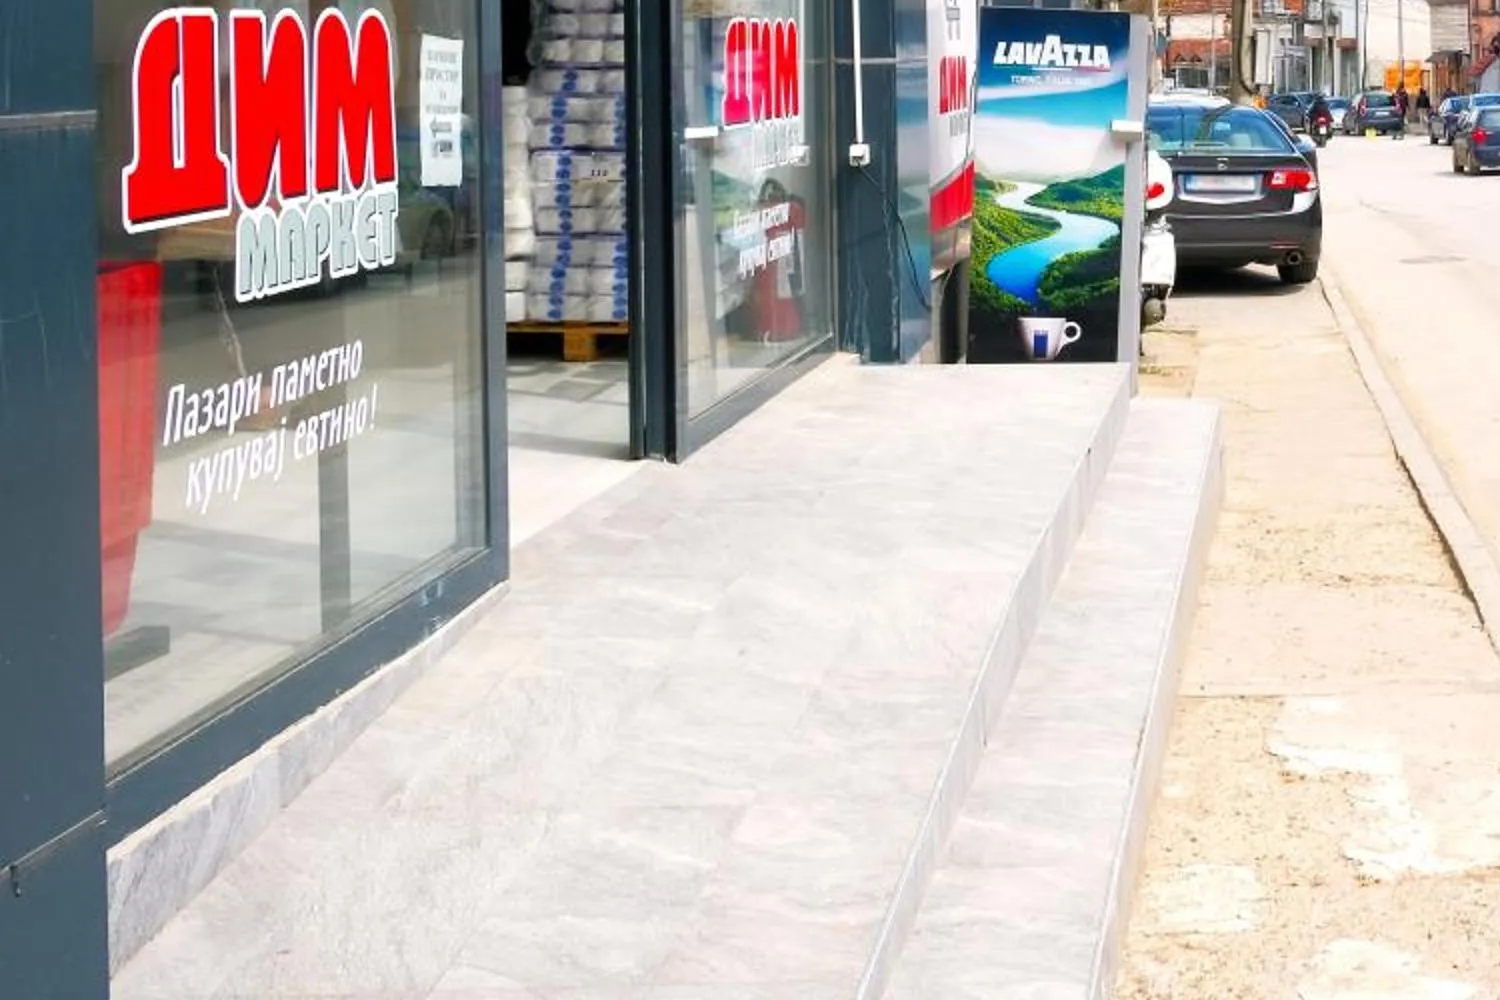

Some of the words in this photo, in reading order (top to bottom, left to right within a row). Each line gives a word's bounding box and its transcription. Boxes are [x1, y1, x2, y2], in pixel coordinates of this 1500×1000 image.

[723, 18, 799, 128] ДИМ
[993, 35, 1111, 69] LAVAZZA
[125, 10, 397, 230] ДИМ
[238, 193, 398, 299] МАРКЕТ
[163, 372, 262, 447] Пазари
[270, 340, 363, 409] паметно
[186, 417, 287, 515] купувај
[293, 383, 378, 461] евтино!
